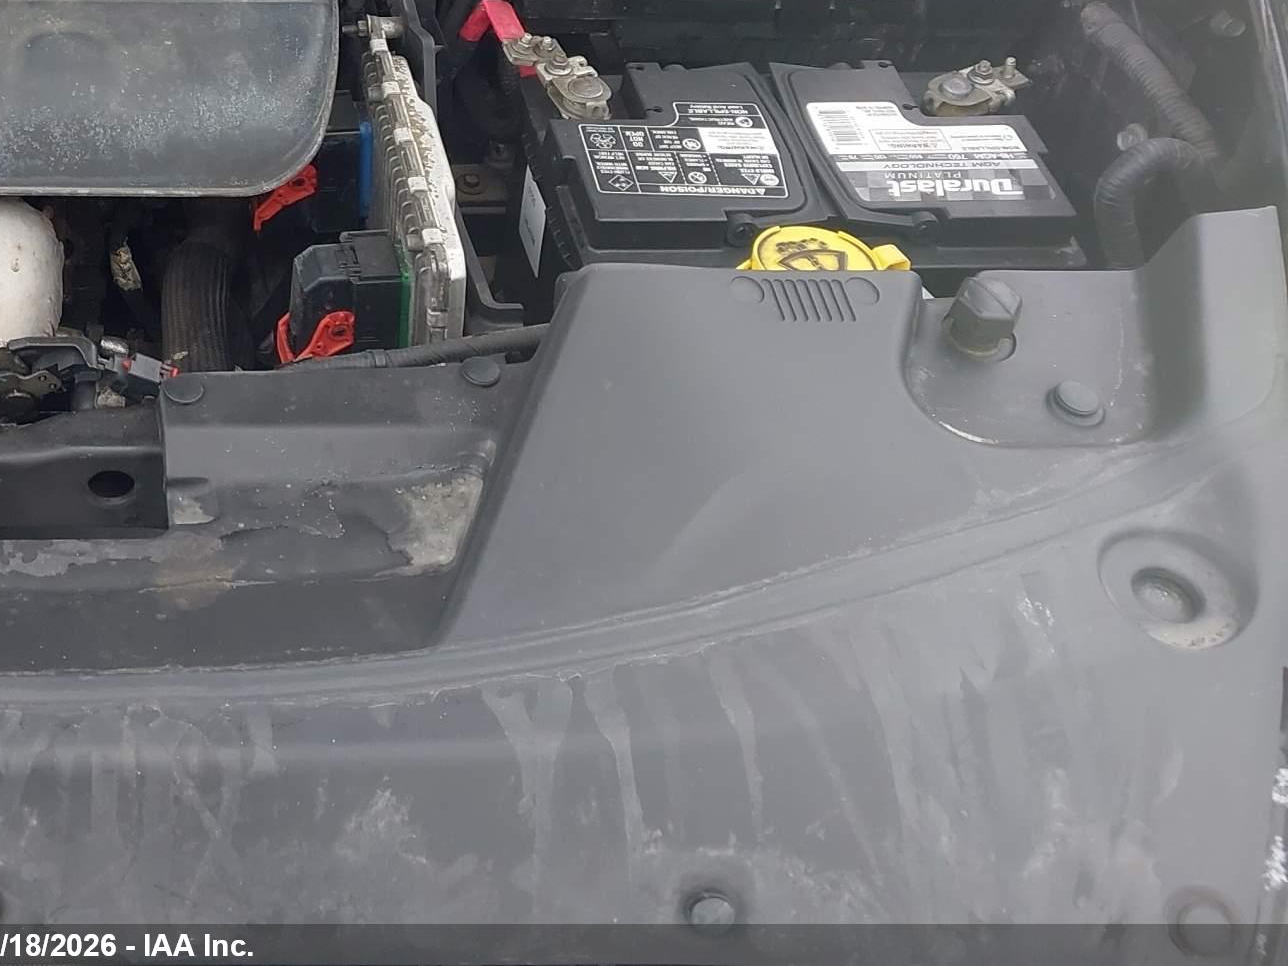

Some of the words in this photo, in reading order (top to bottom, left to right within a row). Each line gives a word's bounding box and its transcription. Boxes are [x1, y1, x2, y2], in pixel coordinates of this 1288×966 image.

[884, 171, 961, 179] PLATINUM
[660, 185, 756, 196] DANGER/POISON
[886, 178, 1024, 197] Duralast
